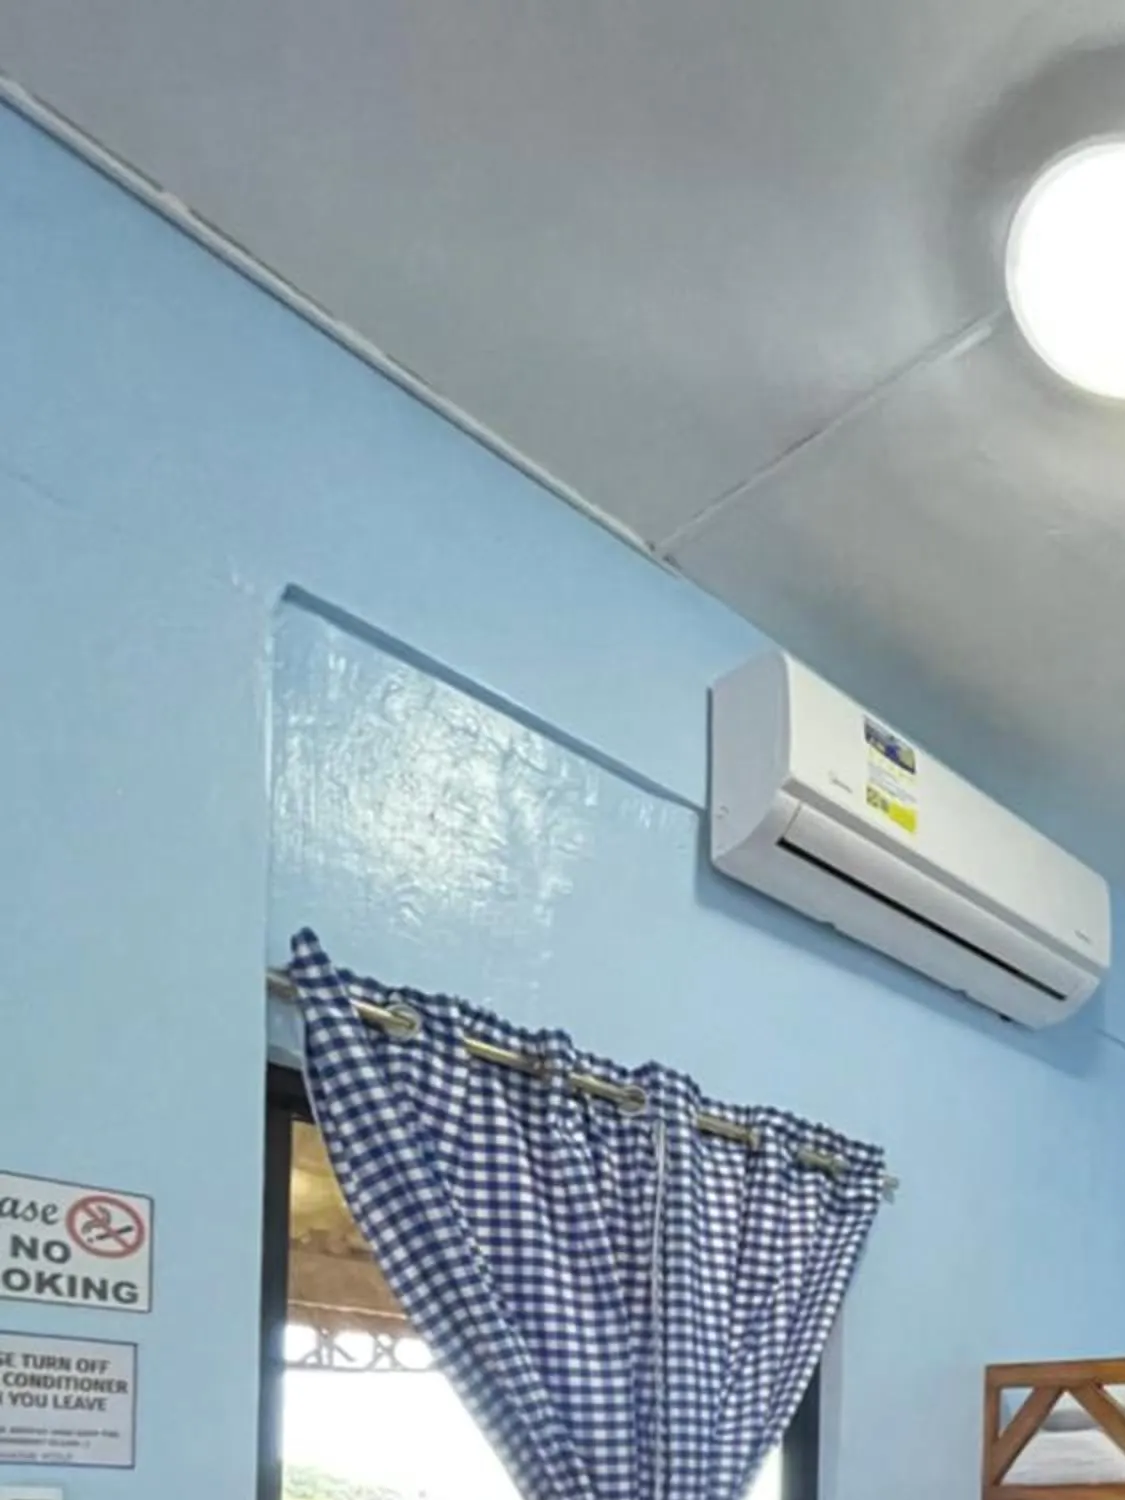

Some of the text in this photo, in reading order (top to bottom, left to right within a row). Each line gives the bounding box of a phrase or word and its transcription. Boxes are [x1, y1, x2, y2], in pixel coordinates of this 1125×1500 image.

[10, 1234, 71, 1264] NO
[2, 1267, 139, 1304] OKING
[22, 1353, 72, 1372] TURN
[76, 1358, 111, 1375] OFF
[2, 1371, 129, 1394] CONDITIONER
[9, 1391, 49, 1409] YOU
[53, 1394, 108, 1412] LEAVE
